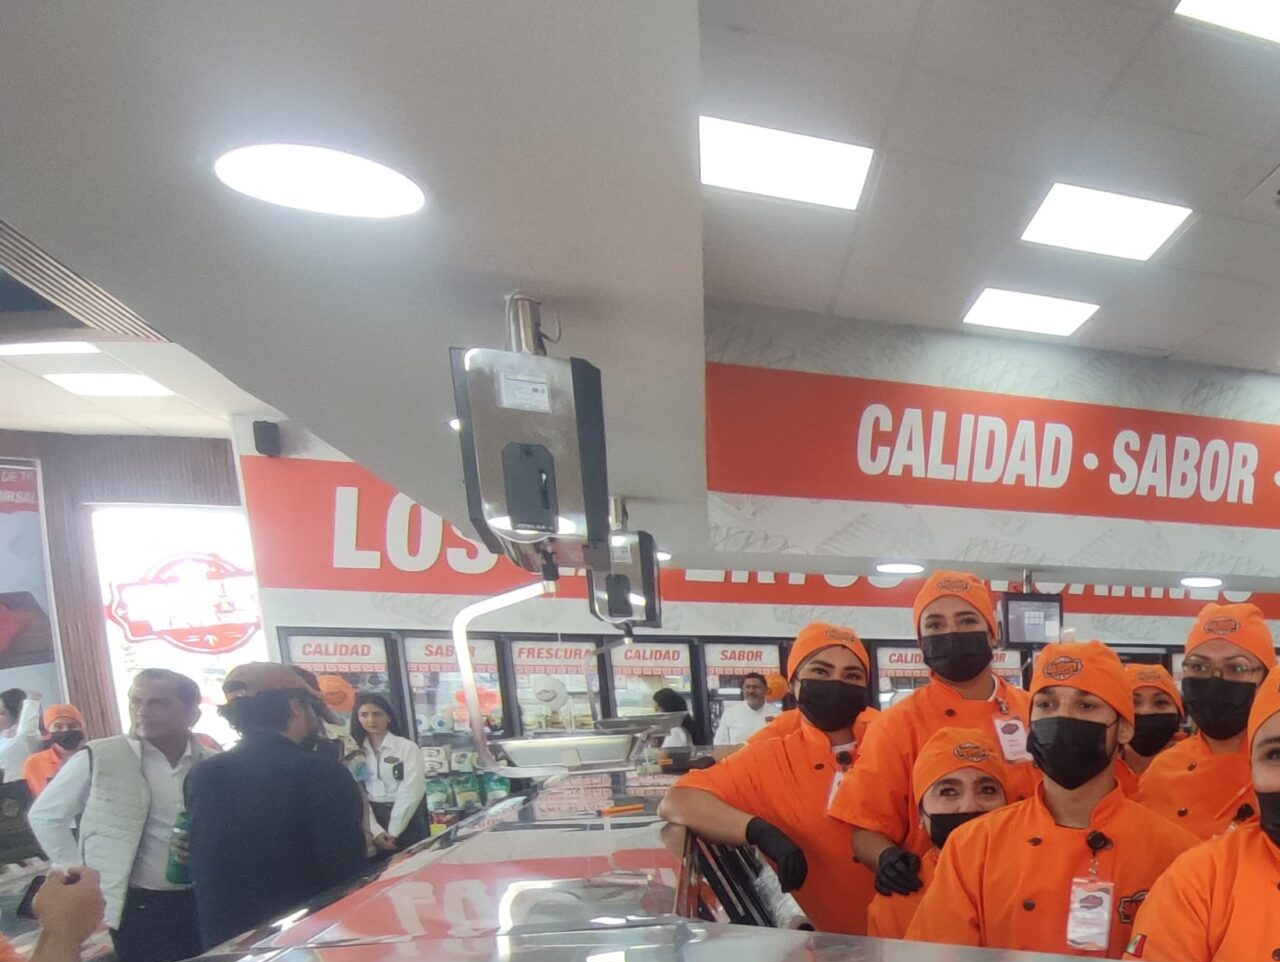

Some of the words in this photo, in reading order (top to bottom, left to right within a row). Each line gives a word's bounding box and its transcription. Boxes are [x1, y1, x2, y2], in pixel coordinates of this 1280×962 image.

[857, 403, 1073, 489] CALIDAD
[1108, 429, 1260, 504] SABOR
[302, 643, 371, 657] CALIDAD
[424, 644, 476, 657] SABR
[623, 649, 681, 661] CALIDAD
[720, 650, 763, 662] SABOR
[888, 652, 923, 664] CALID
